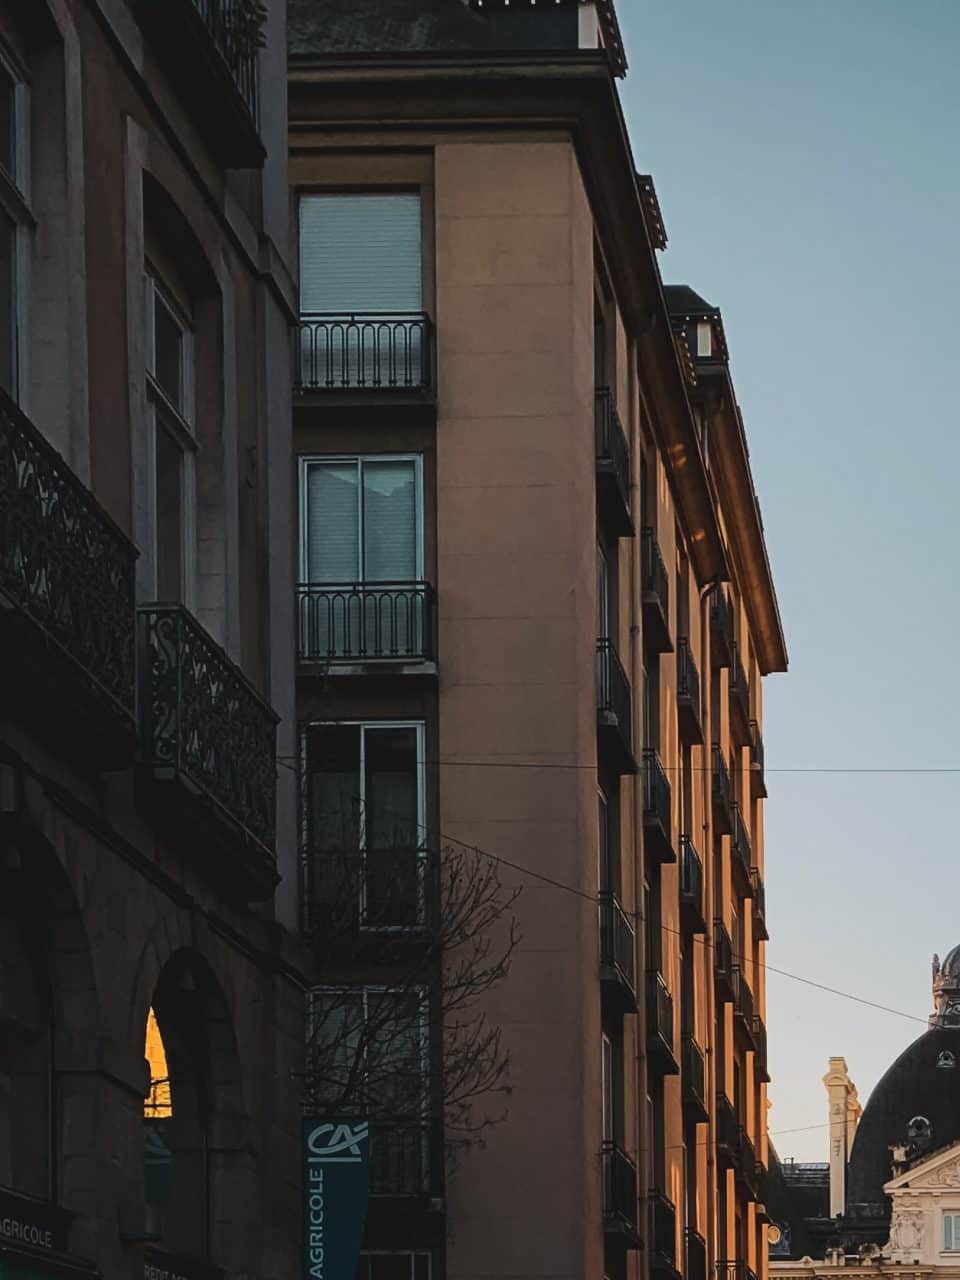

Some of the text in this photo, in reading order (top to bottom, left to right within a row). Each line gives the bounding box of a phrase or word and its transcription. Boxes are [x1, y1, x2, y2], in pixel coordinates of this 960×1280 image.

[308, 1121, 369, 1155] CA
[0, 1217, 52, 1248] GRICOLE
[309, 1168, 324, 1279] AGRICOLE
